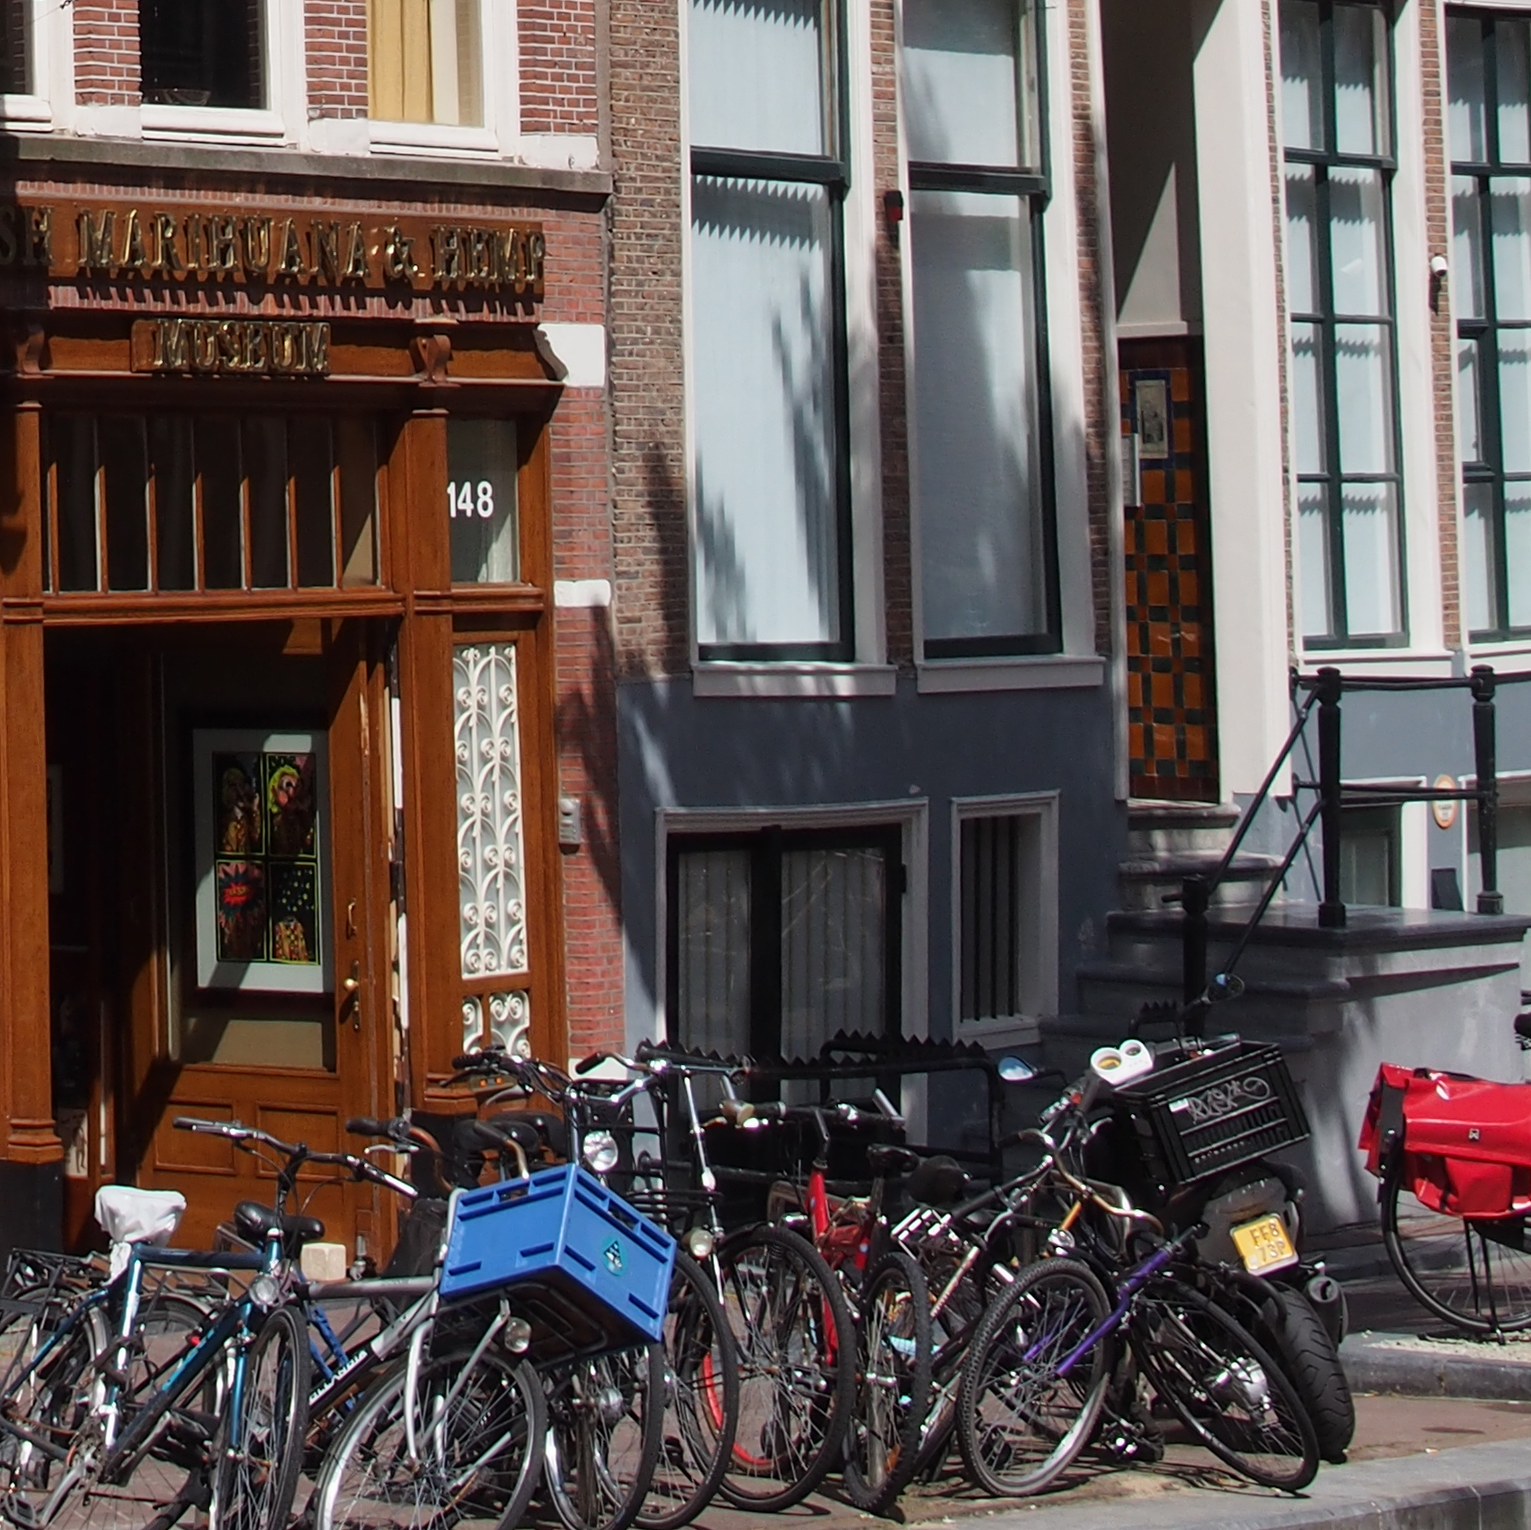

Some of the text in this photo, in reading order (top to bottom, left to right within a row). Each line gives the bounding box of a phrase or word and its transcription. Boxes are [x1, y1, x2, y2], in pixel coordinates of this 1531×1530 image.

[77, 208, 369, 278] MARIHUANA
[384, 225, 424, 279] &
[431, 224, 546, 284] HEMP
[153, 318, 330, 372] MUSEUM
[446, 480, 494, 518] 148
